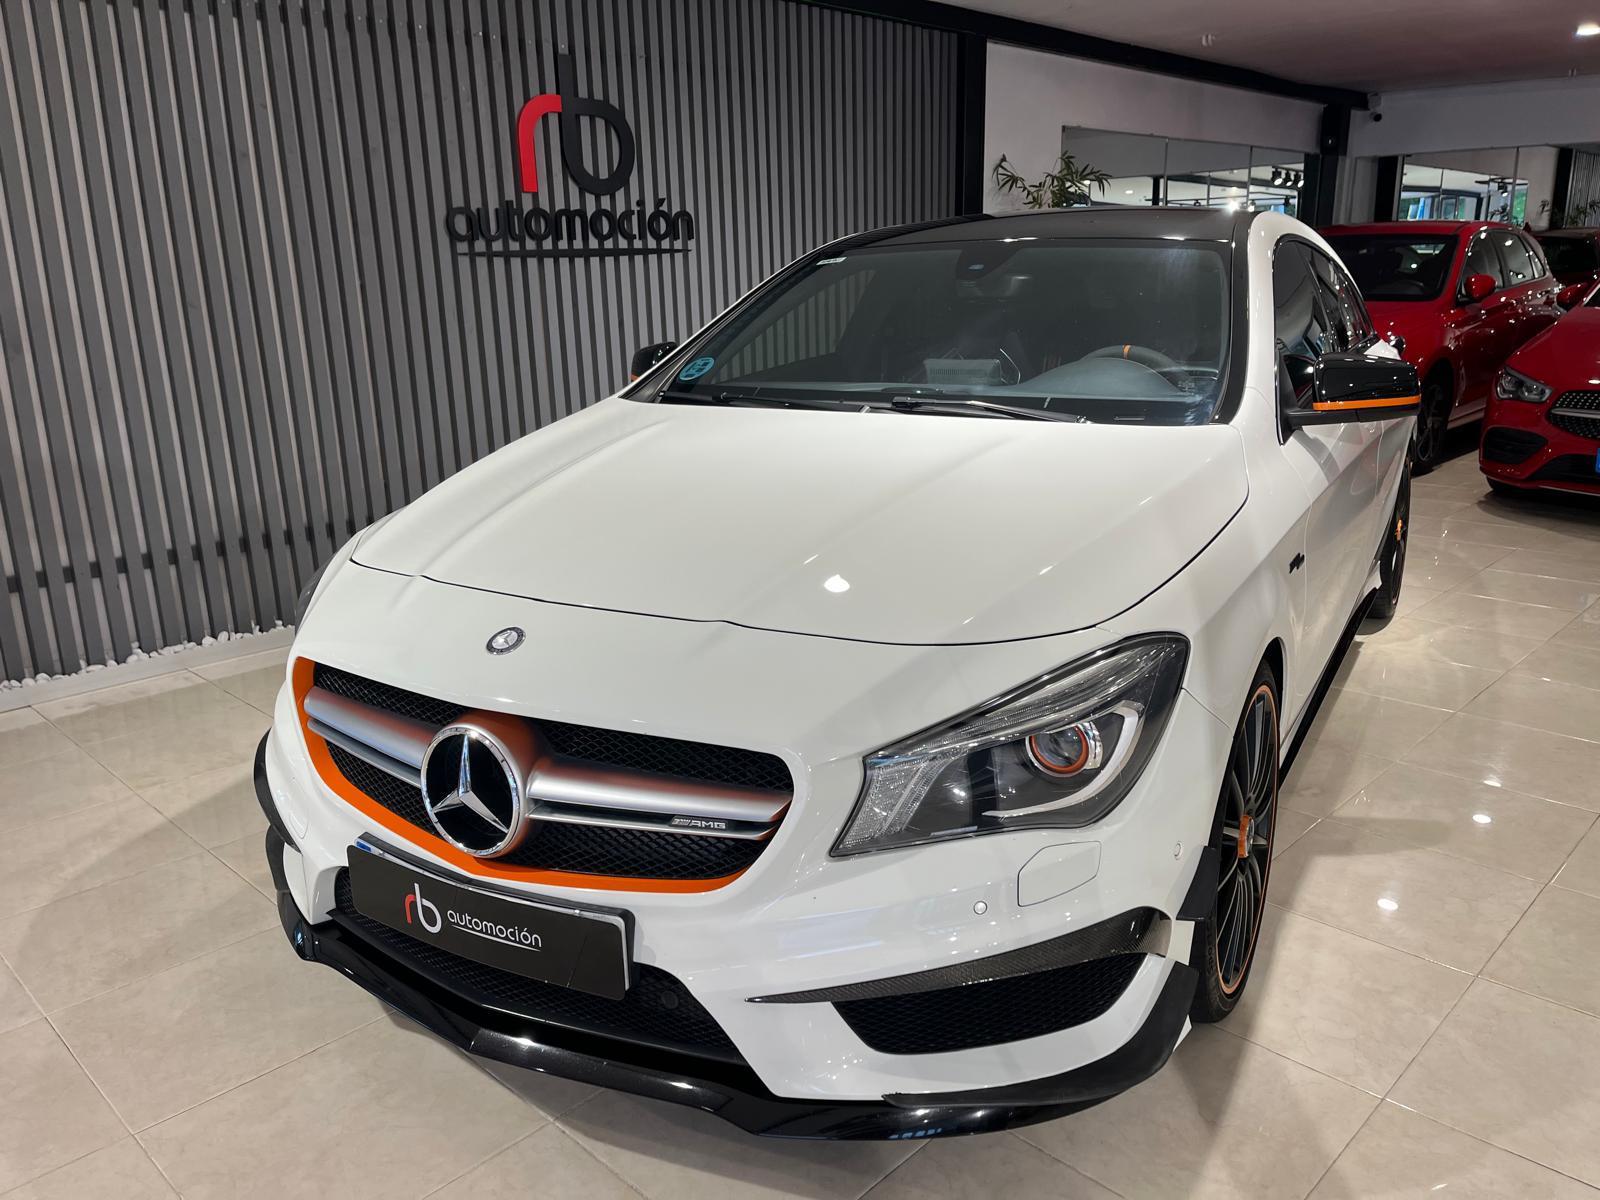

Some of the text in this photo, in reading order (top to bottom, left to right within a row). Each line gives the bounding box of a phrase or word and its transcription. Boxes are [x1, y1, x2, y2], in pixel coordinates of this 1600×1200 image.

[518, 53, 635, 196] rb
[446, 198, 694, 242] automoción
[688, 819, 726, 830] AMG
[404, 882, 542, 948] rb automoción
